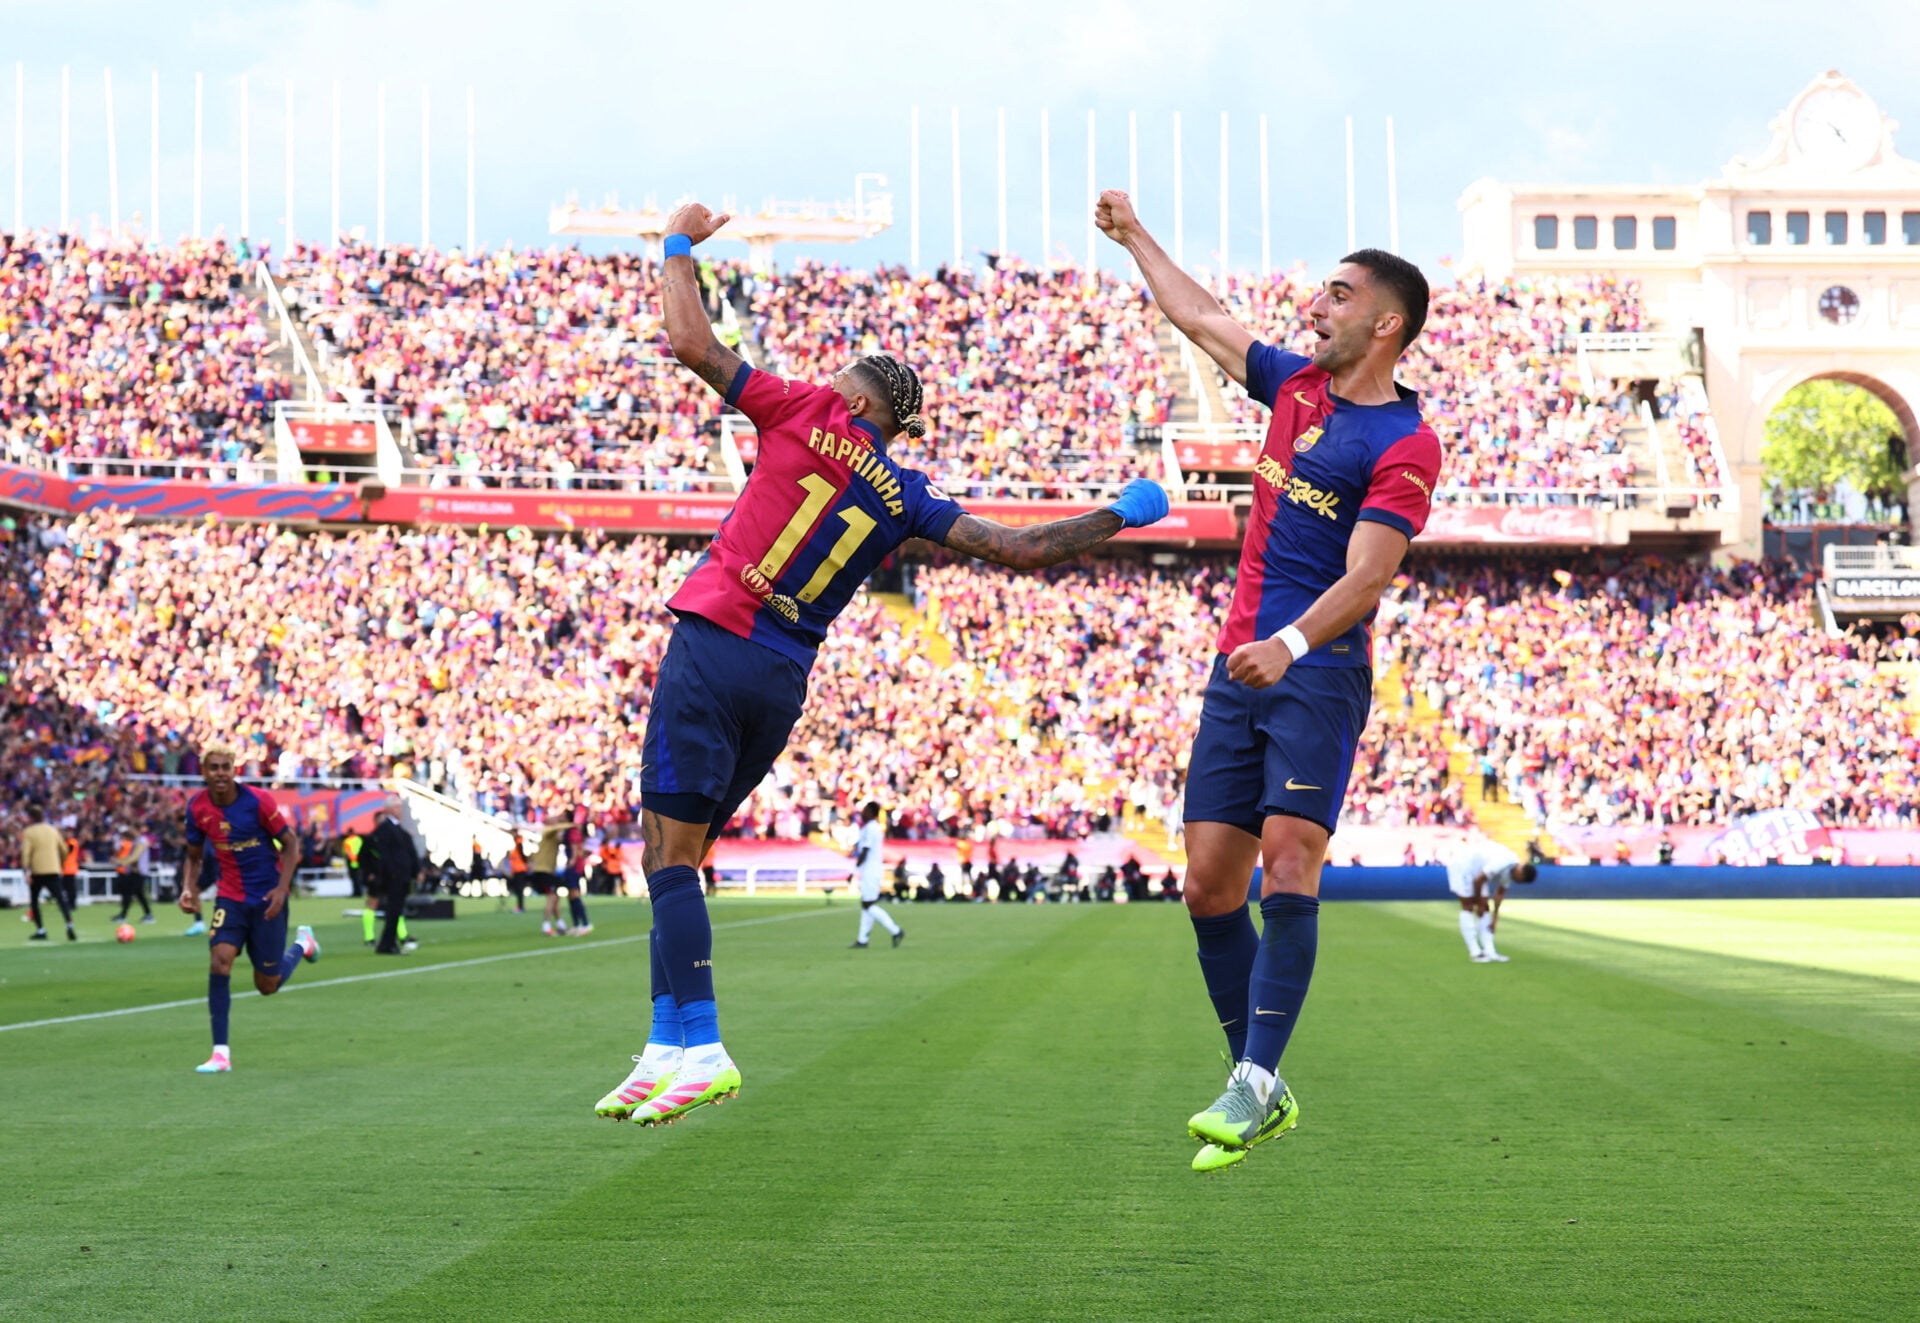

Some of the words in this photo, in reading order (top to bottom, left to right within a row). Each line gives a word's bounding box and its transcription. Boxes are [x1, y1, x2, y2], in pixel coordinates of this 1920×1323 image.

[808, 426, 904, 517] RAPHINHA
[757, 472, 877, 603] 11
[762, 592, 800, 623] ACNUR
